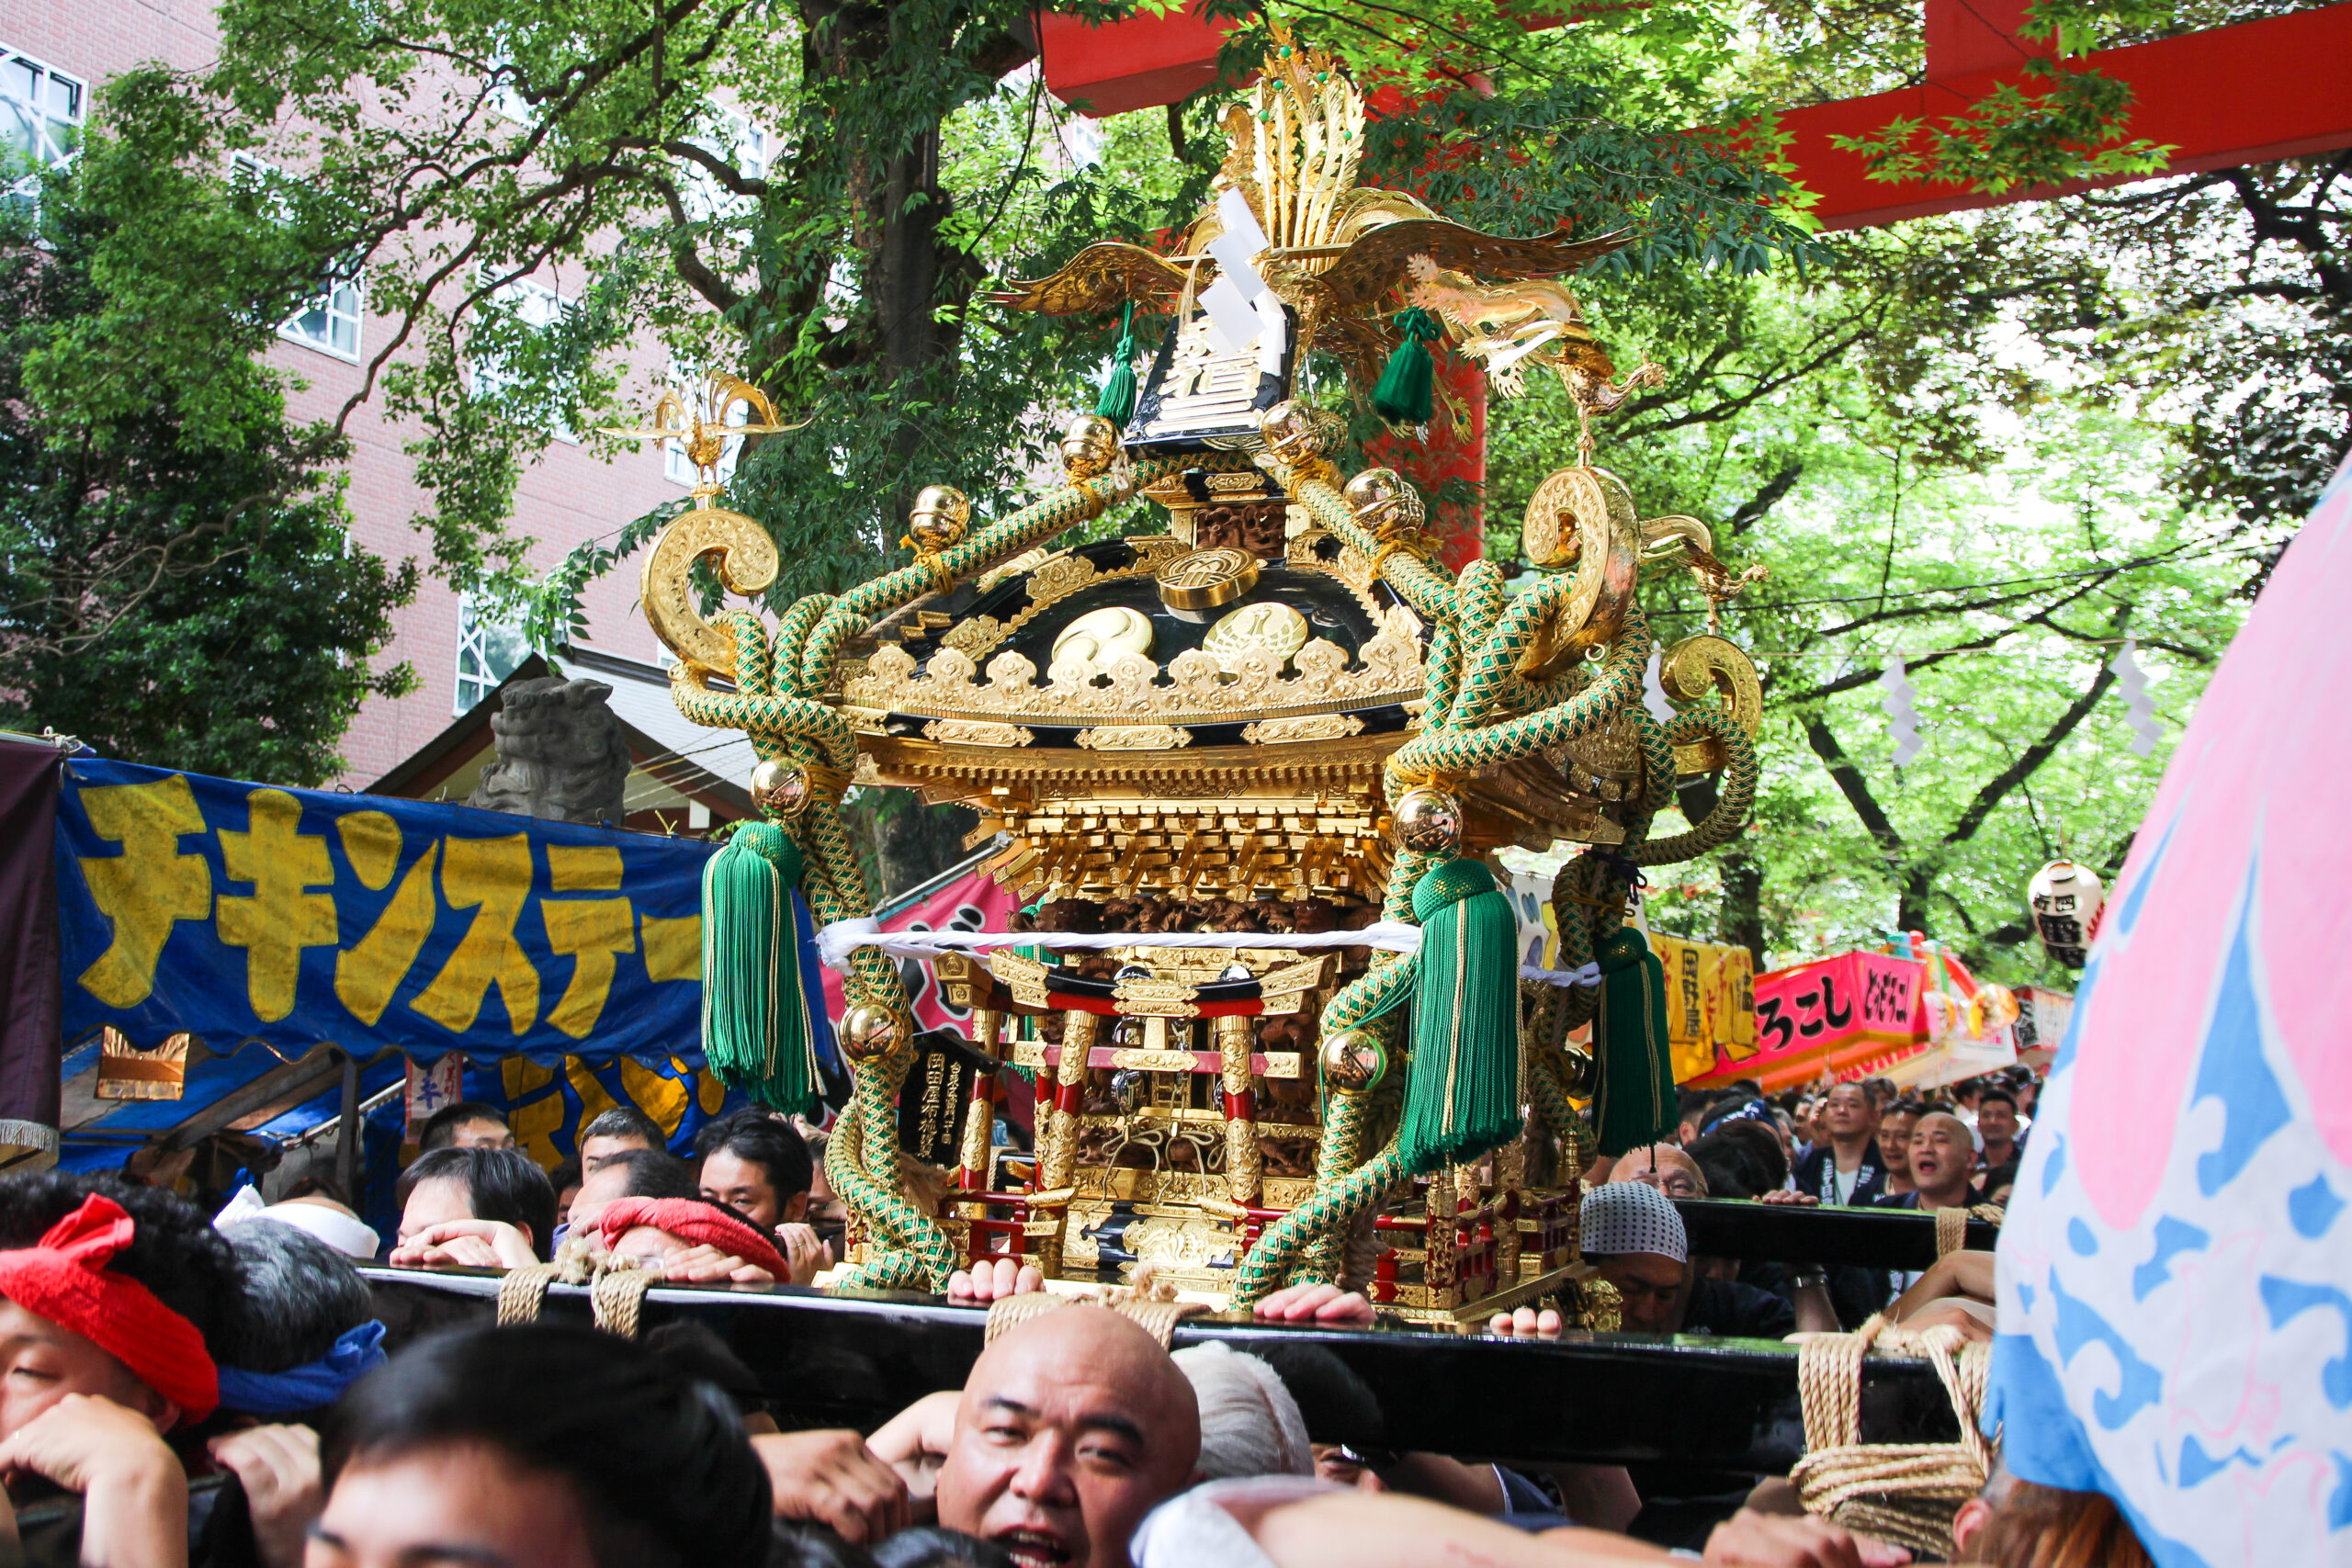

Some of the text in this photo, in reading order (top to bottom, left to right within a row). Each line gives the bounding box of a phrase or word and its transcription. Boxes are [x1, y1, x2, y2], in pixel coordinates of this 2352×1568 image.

[77, 773, 702, 1040] チキンステー
[1757, 976, 1853, 1051] ろこし
